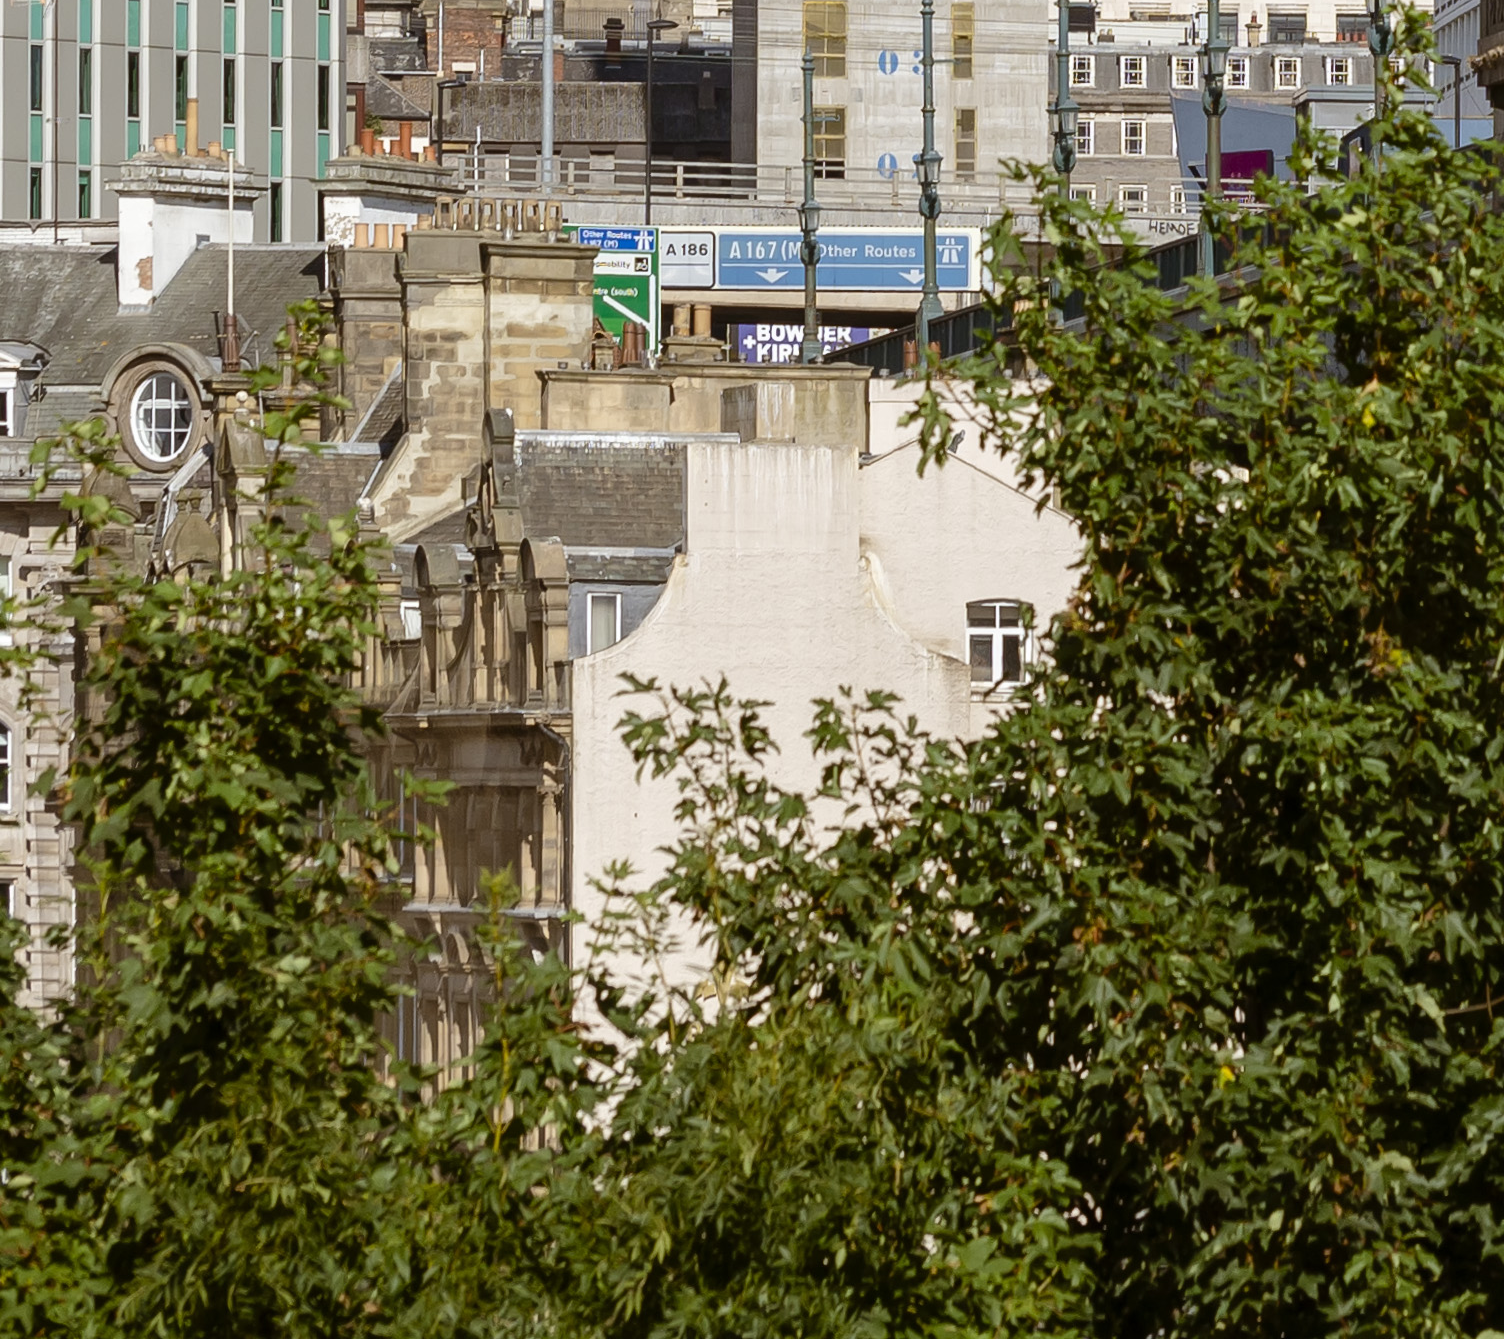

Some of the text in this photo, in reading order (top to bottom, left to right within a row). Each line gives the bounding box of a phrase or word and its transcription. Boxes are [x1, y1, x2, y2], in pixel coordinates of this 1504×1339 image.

[582, 229, 632, 240] Other Routes
[864, 244, 916, 258] Routes
